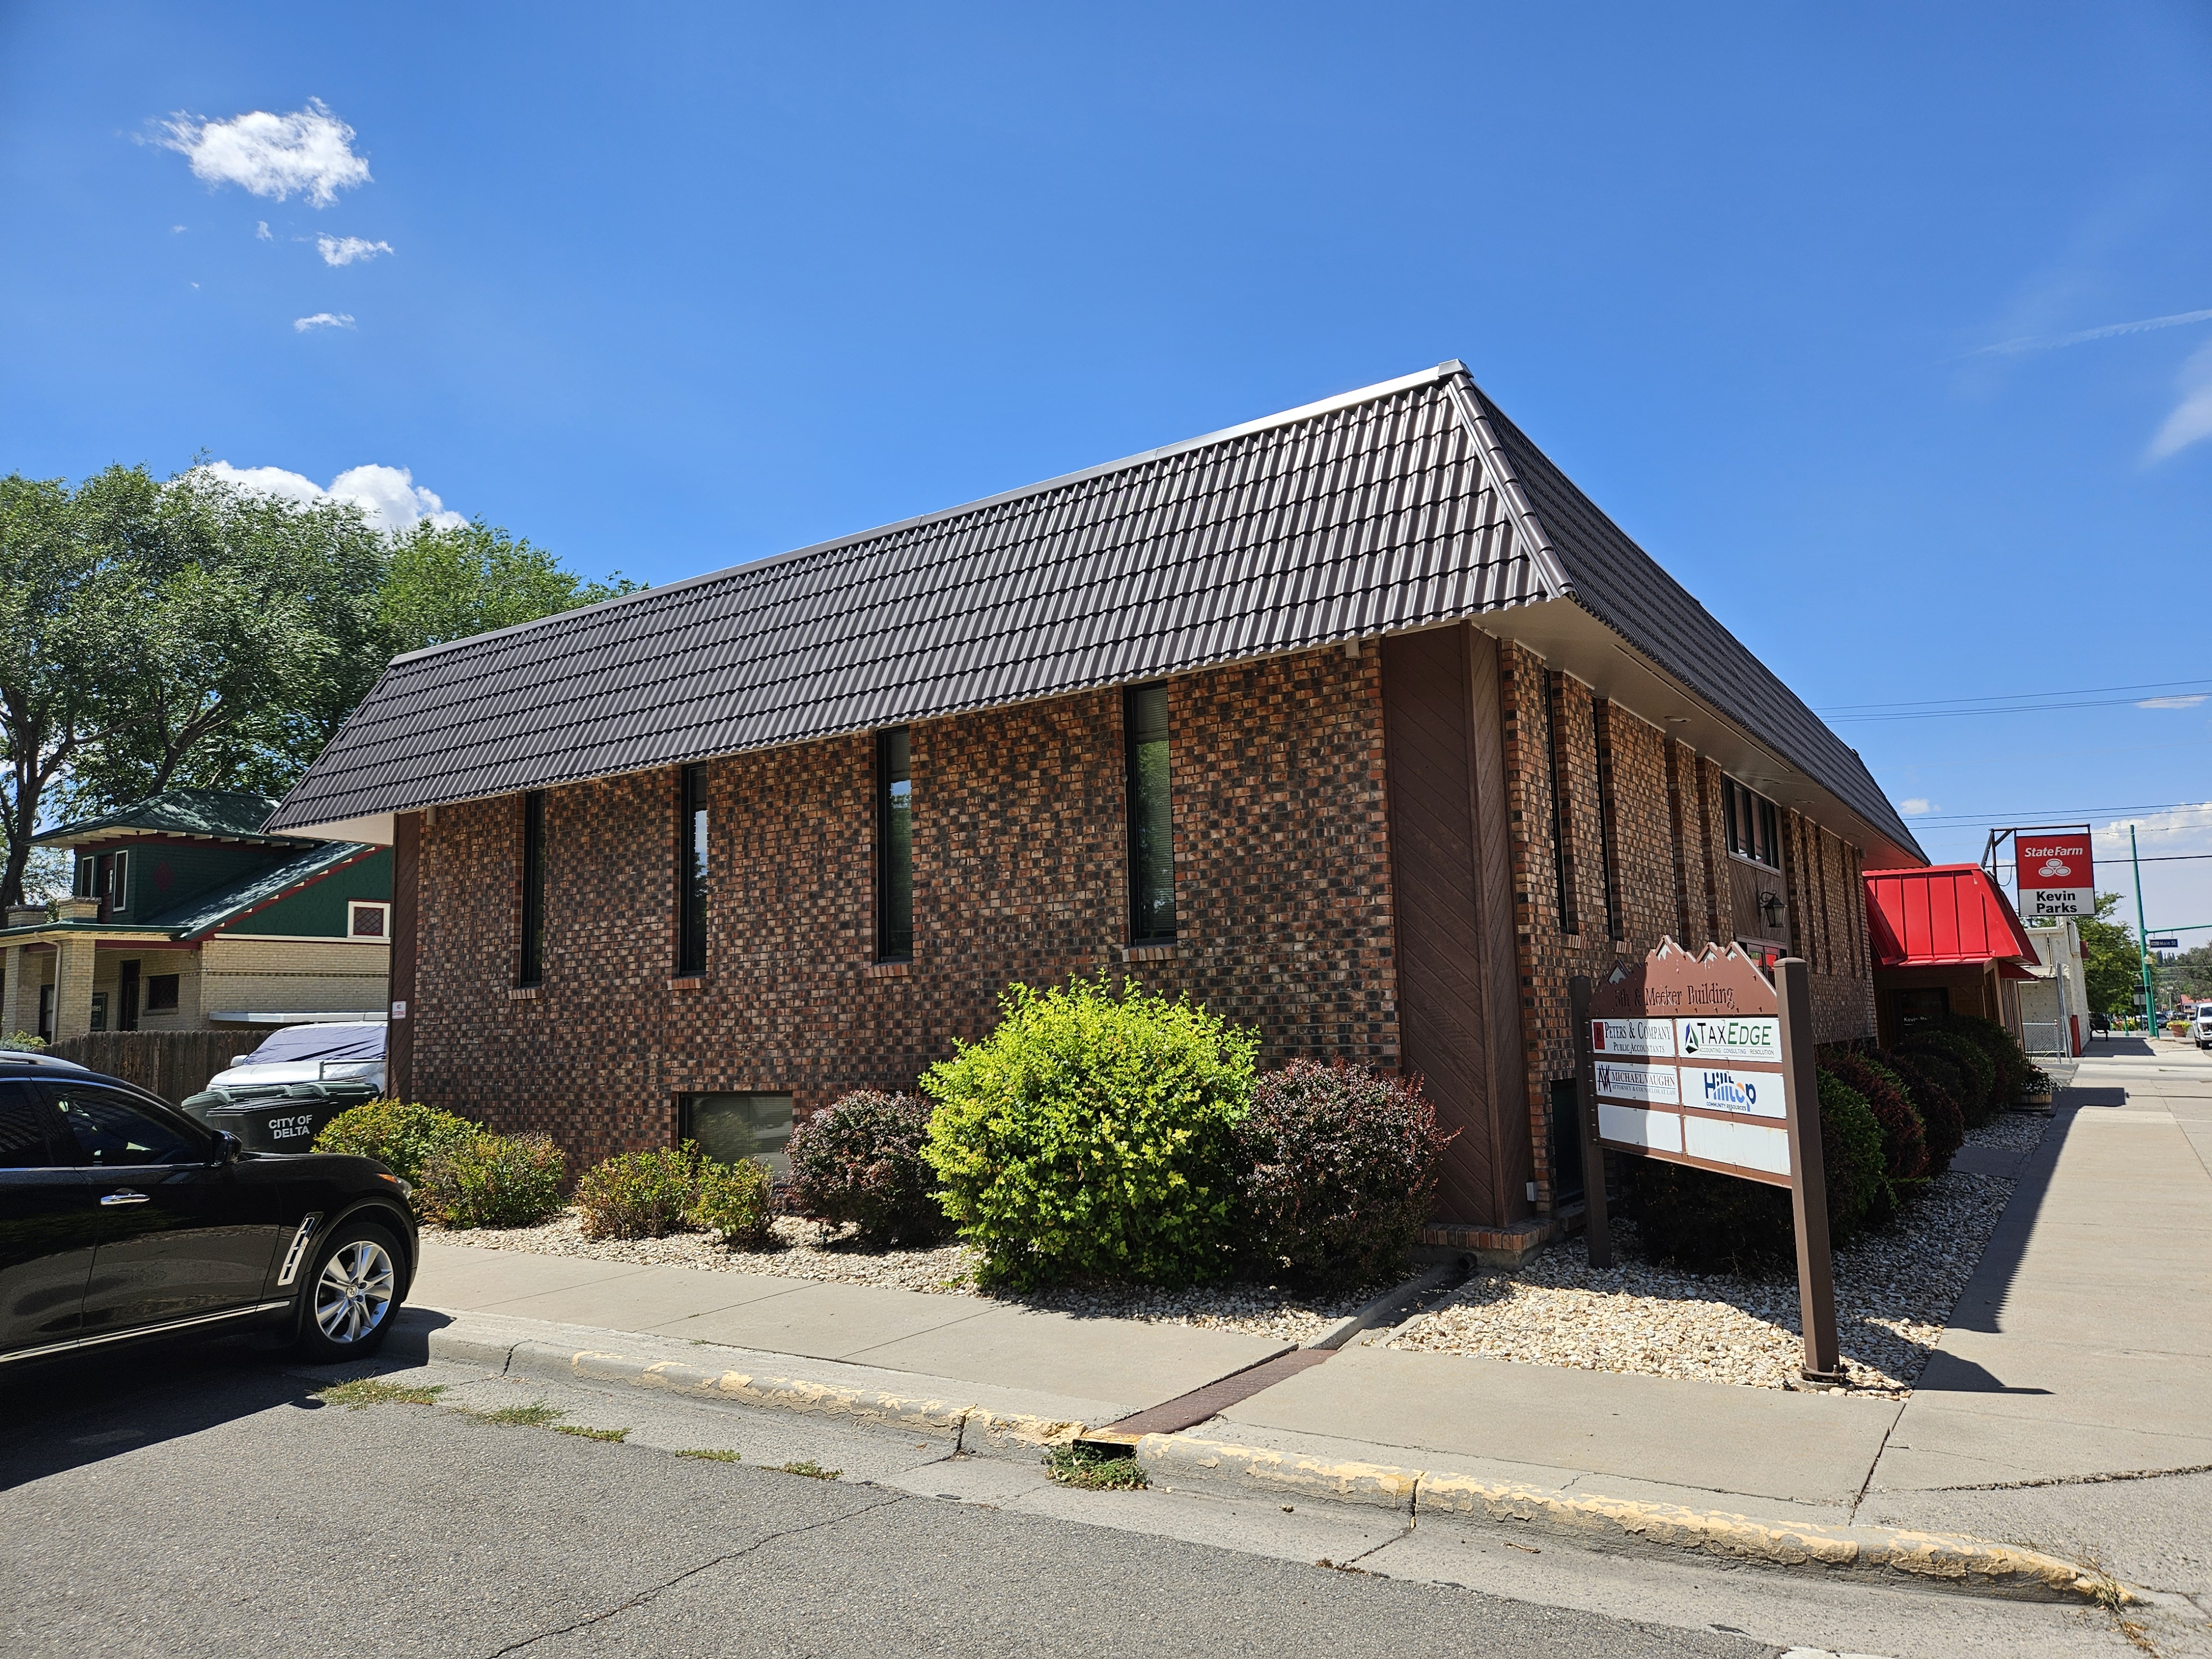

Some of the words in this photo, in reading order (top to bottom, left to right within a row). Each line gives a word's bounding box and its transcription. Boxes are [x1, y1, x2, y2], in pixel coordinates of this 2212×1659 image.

[2036, 890, 2076, 901] Kevin
[2036, 902, 2077, 913] Parks
[1615, 988, 1630, 1006] 5th
[1635, 988, 1641, 1006] &
[1645, 985, 1682, 1006] Meeker
[1687, 983, 1735, 1010] Building
[1604, 1021, 1626, 1039] PETERS
[1629, 1021, 1635, 1039] &
[1637, 1021, 1671, 1040] COMPANY
[1614, 1042, 1630, 1051] PUBLIC
[1630, 1042, 1665, 1053] ACCOUNTANTS
[1611, 1072, 1644, 1084] MICHAEL
[1645, 1074, 1675, 1087] VAUGHN
[1704, 1072, 1756, 1112] Hilltop
[269, 1117, 295, 1129] CITY
[297, 1114, 312, 1125] OF
[273, 1125, 310, 1139] DELTA
